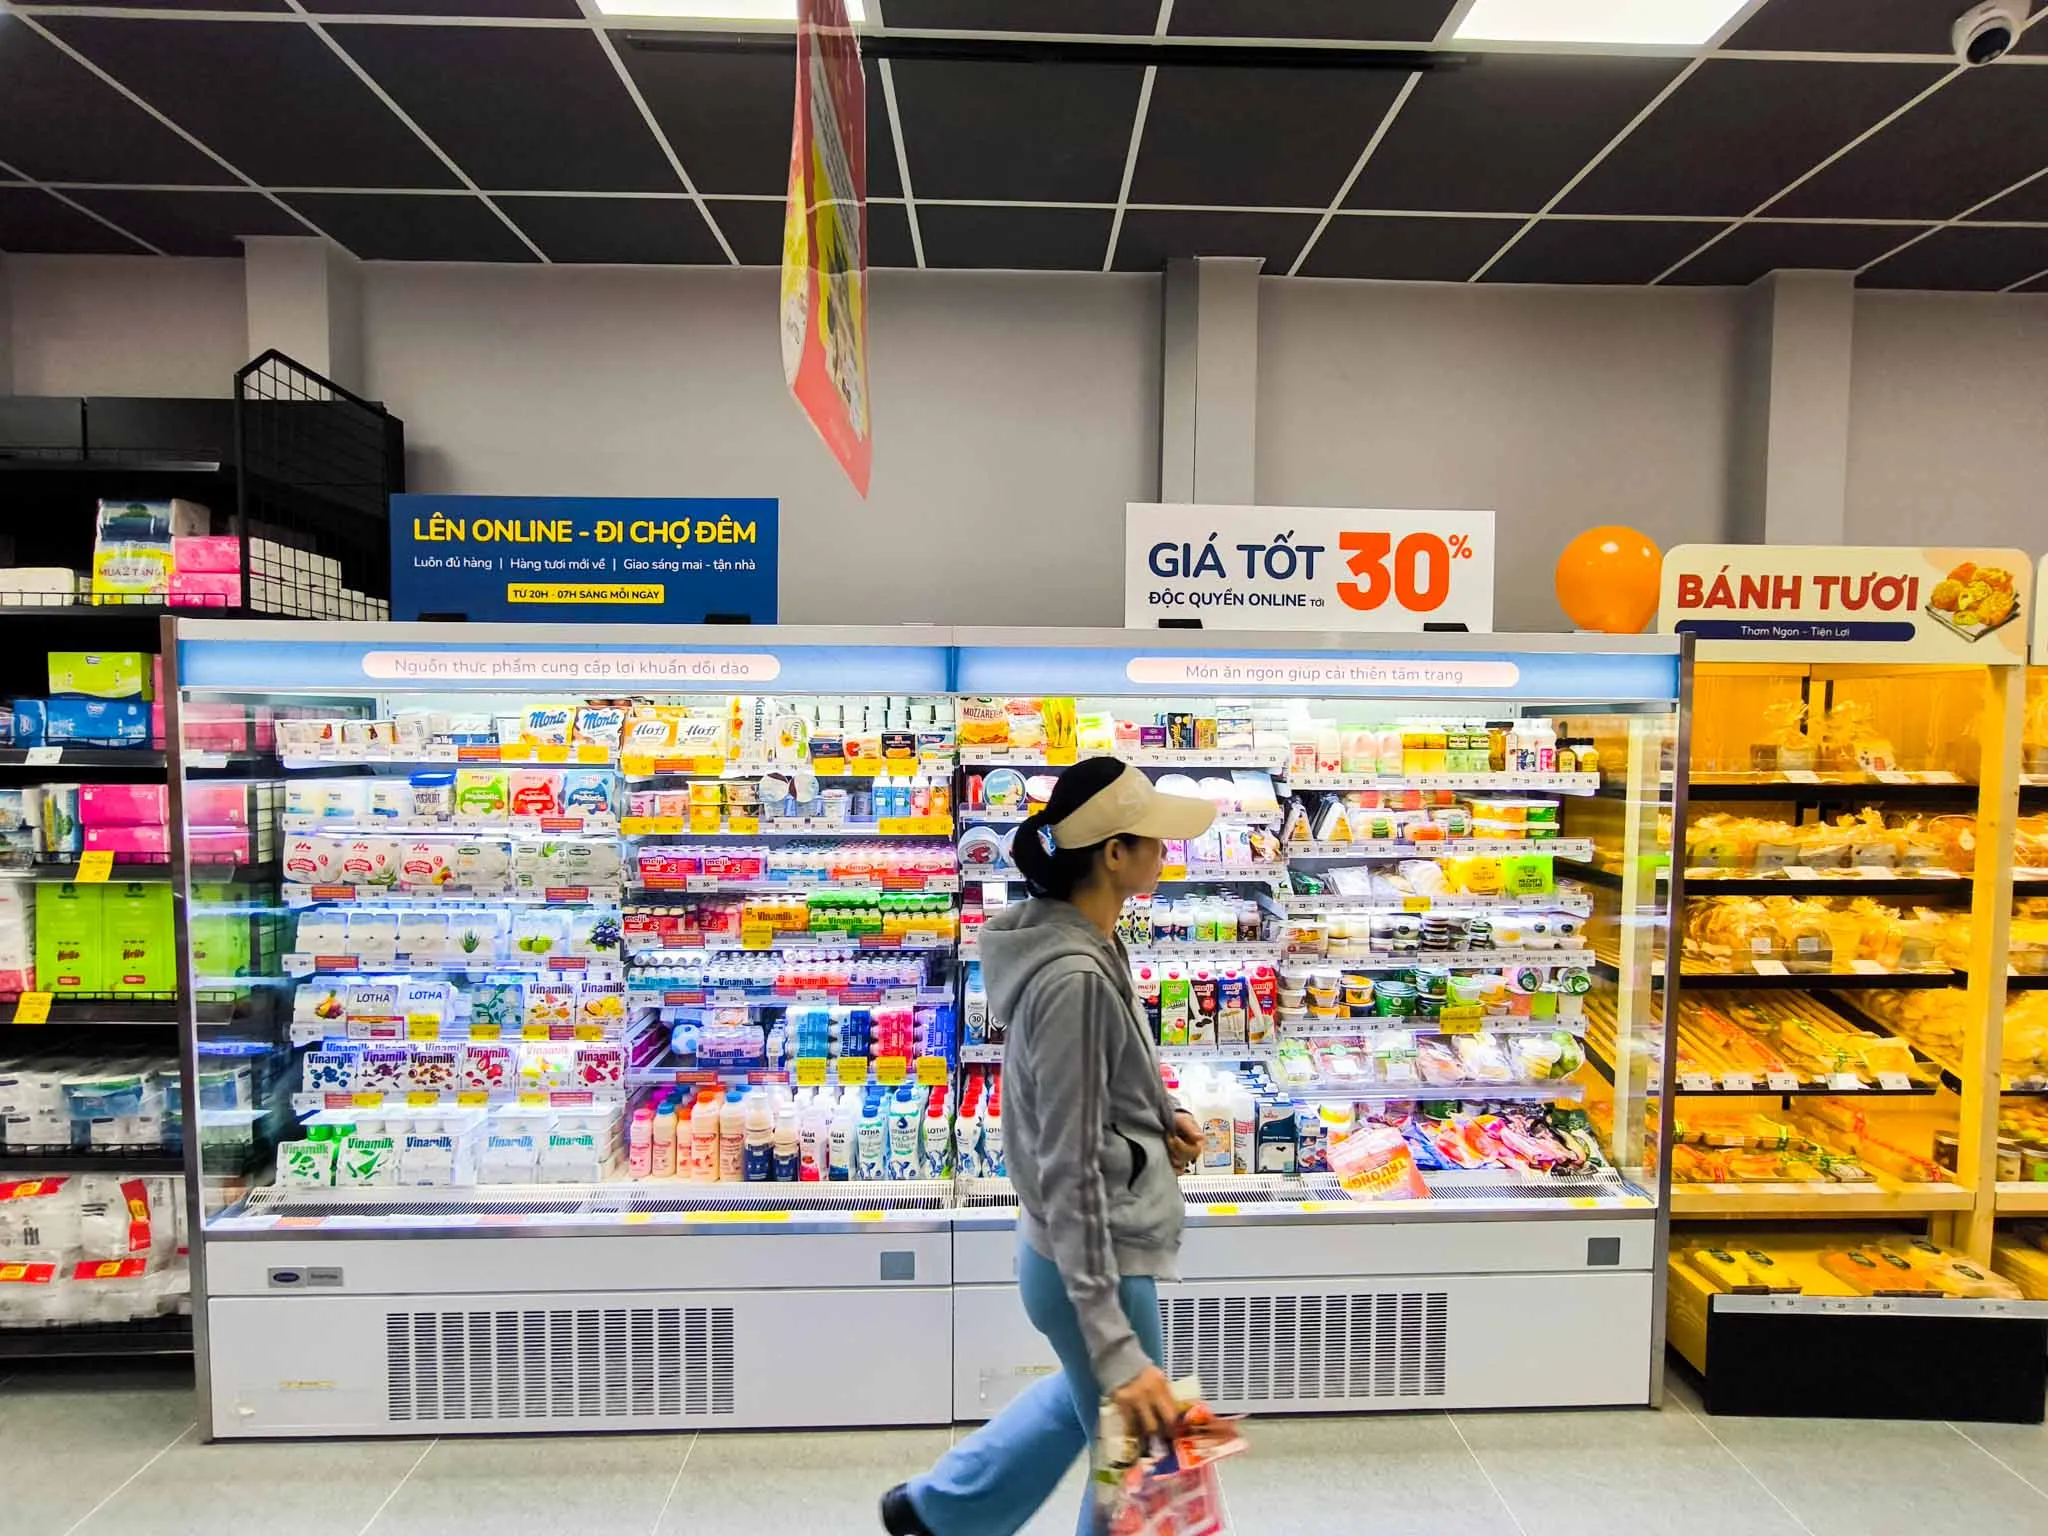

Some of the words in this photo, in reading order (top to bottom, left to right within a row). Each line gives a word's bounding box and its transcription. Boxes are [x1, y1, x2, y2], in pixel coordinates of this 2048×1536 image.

[413, 511, 465, 541] LÊN
[472, 519, 573, 542] ONLINE
[594, 520, 623, 543] ĐI
[629, 517, 691, 549] CHỢ
[695, 514, 757, 543] ĐÊM
[1149, 532, 1226, 578] GIÁ
[1236, 530, 1325, 580] TỐT
[414, 556, 443, 568] Luôn
[445, 556, 461, 568] đủ
[463, 556, 492, 570] hàng
[510, 557, 541, 571] Hàng
[544, 558, 566, 569] tươi
[568, 558, 589, 570] mới
[624, 558, 650, 570] Giao
[651, 558, 679, 572] sáng
[682, 558, 703, 570] mai
[713, 558, 732, 572] tận
[734, 558, 756, 570] nhà
[1677, 565, 1802, 609] BÁNH
[1813, 571, 1919, 611] TƯƠI
[530, 590, 549, 598] 20H
[557, 590, 577, 599] 07H
[1148, 588, 1184, 608] ĐỘC
[1189, 588, 1244, 608] QUYỀN
[1249, 593, 1306, 607] ONLINE
[1740, 625, 1770, 637] Thơm
[1772, 626, 1800, 639] Ngon
[541, 662, 578, 676] cung
[1186, 665, 1218, 678] Món
[1223, 665, 1241, 679] ăn
[1246, 669, 1284, 681] ngon
[1288, 665, 1321, 681] giúp
[529, 983, 573, 995] Vinamilk
[581, 981, 625, 993] Vinamilk
[356, 993, 391, 1004] LOTHA
[409, 990, 443, 1000] LOTHA
[308, 1053, 353, 1064] Vinamilk
[362, 1051, 407, 1062] Vinamilk
[411, 1053, 455, 1064] Vinamilk
[467, 1047, 510, 1058] Vinamilk
[577, 1051, 621, 1062] Vinamilk
[347, 1138, 394, 1149] Vinamilk
[406, 1136, 453, 1148] Vinamilk
[488, 1136, 535, 1147] Vinamilk
[549, 1135, 594, 1146] Vinamilk
